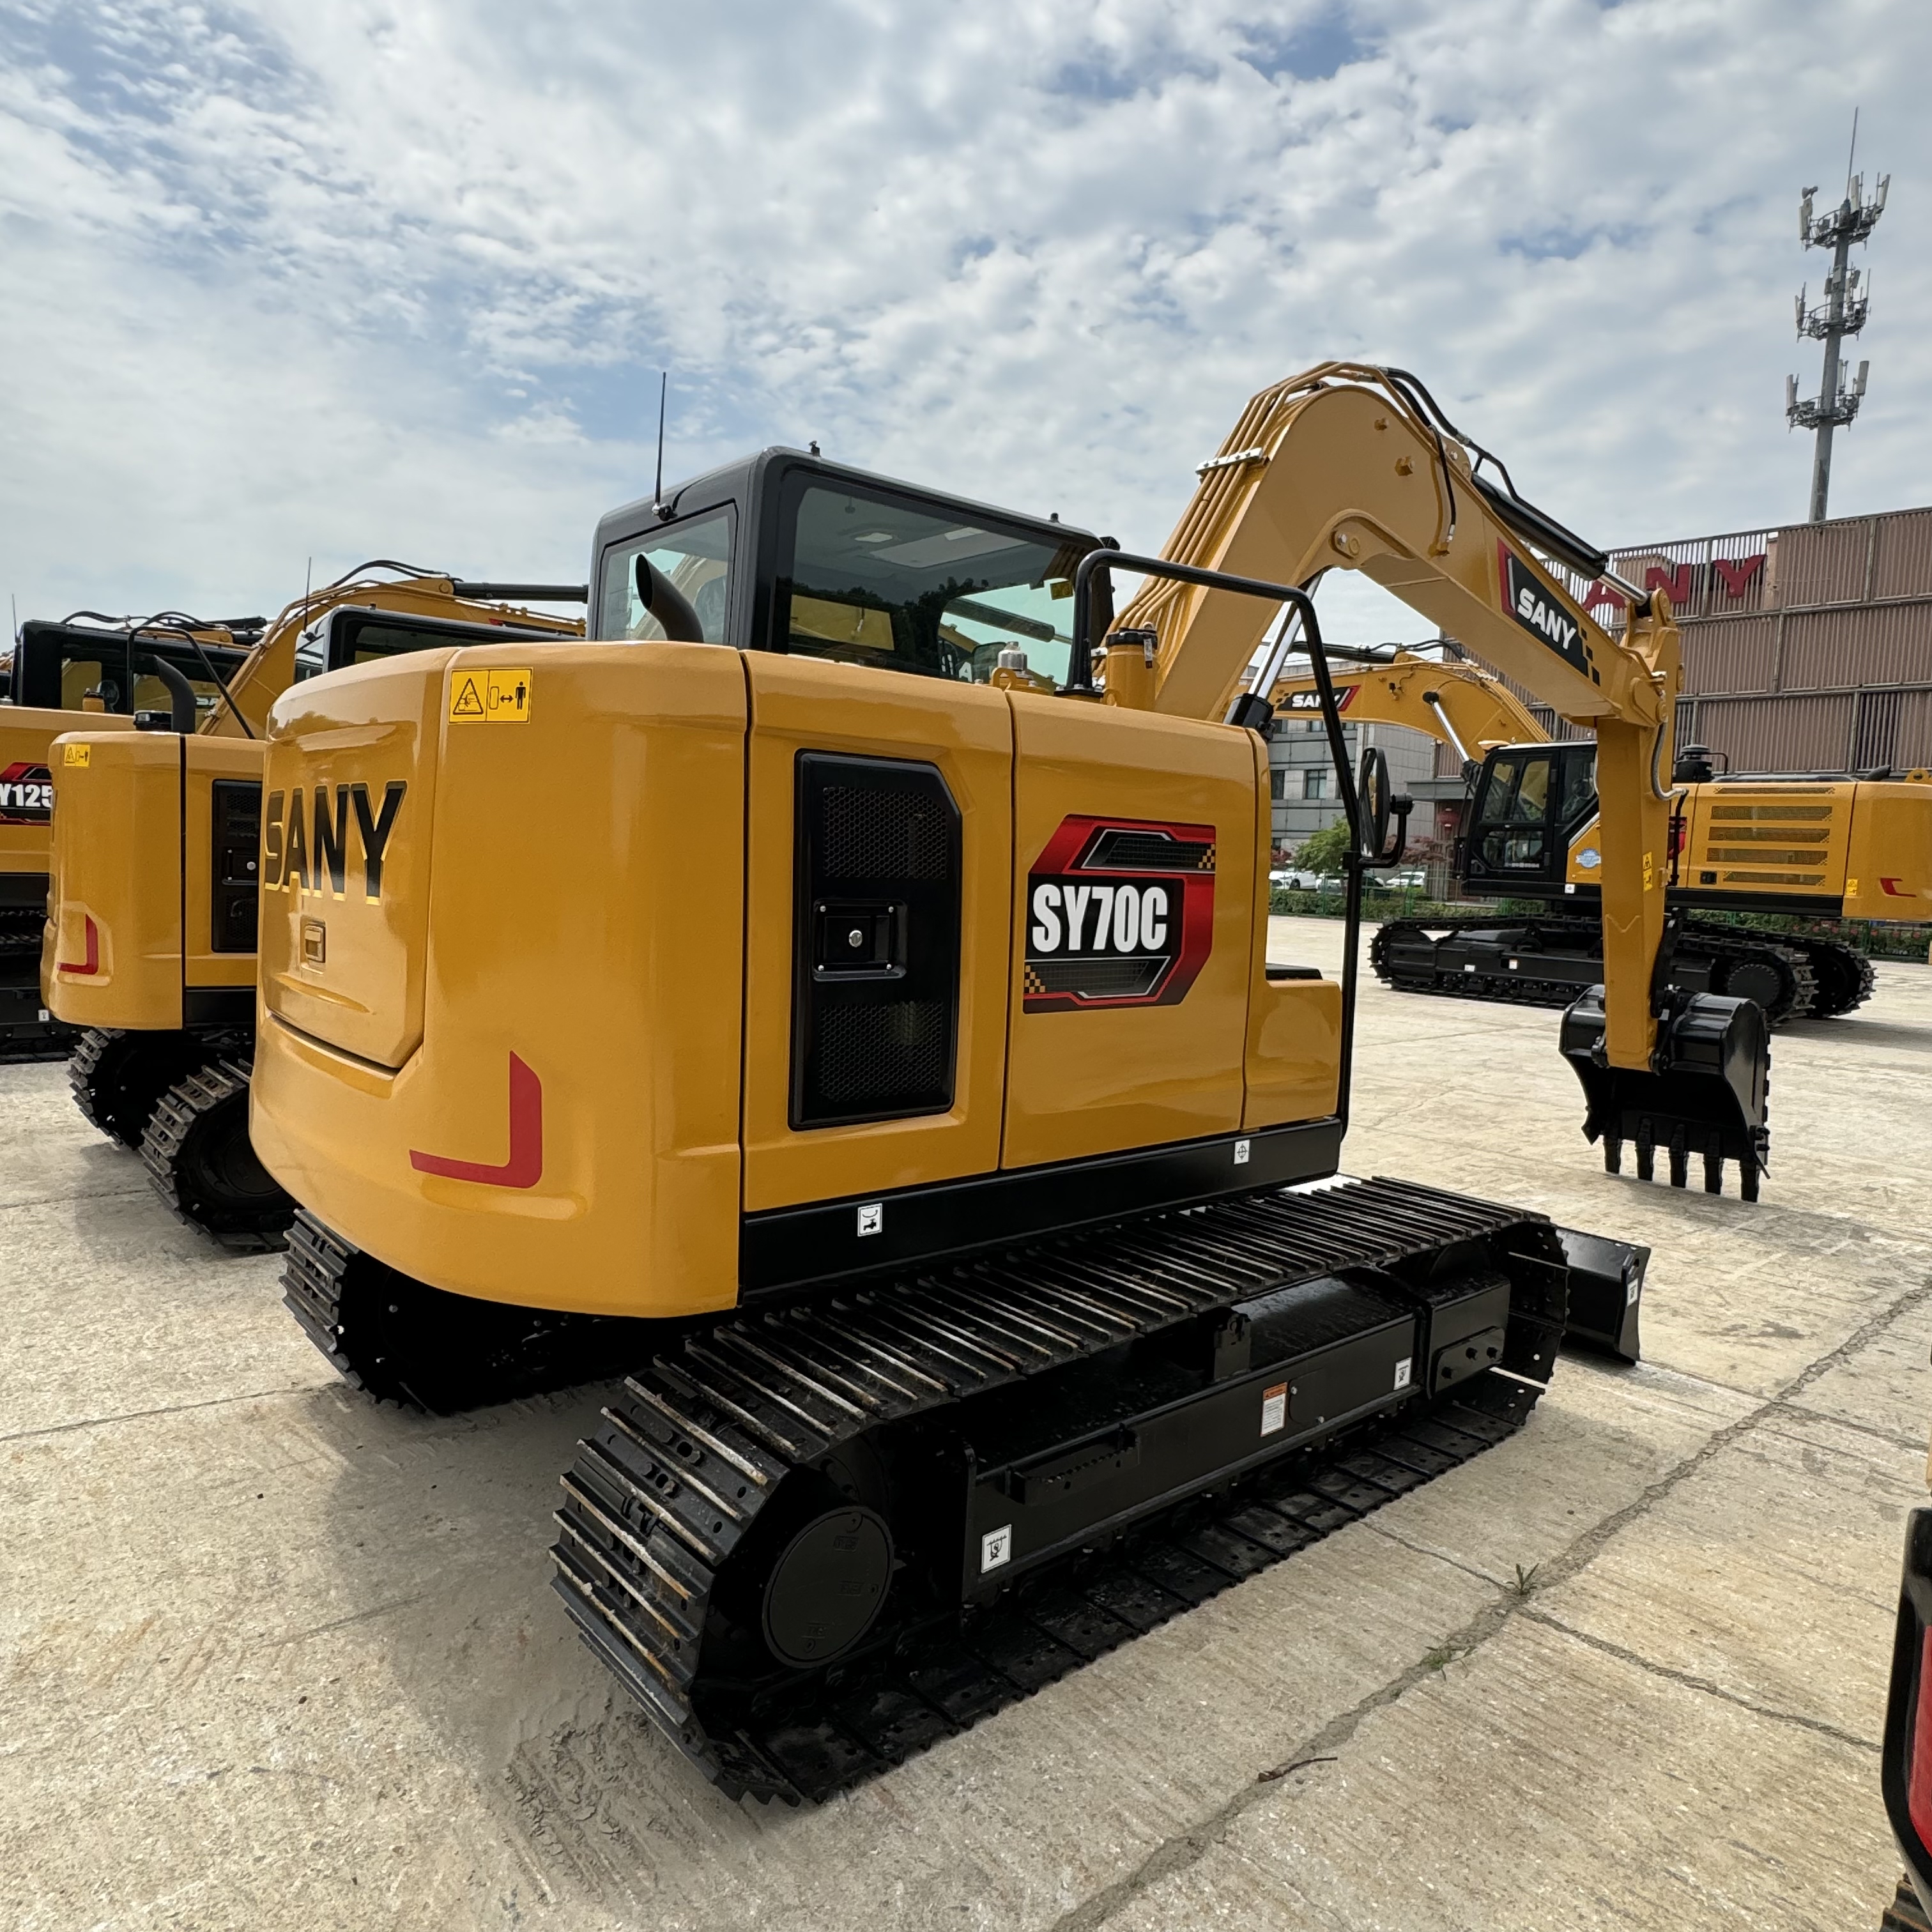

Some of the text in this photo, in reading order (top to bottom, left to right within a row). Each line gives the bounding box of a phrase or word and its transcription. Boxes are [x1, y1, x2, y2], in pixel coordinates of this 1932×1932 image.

[1582, 553, 1767, 611] ANY
[1517, 588, 1577, 650] SANY
[195, 696, 218, 706] SA
[264, 780, 408, 906] SANY
[1032, 884, 1168, 953] SY70C
